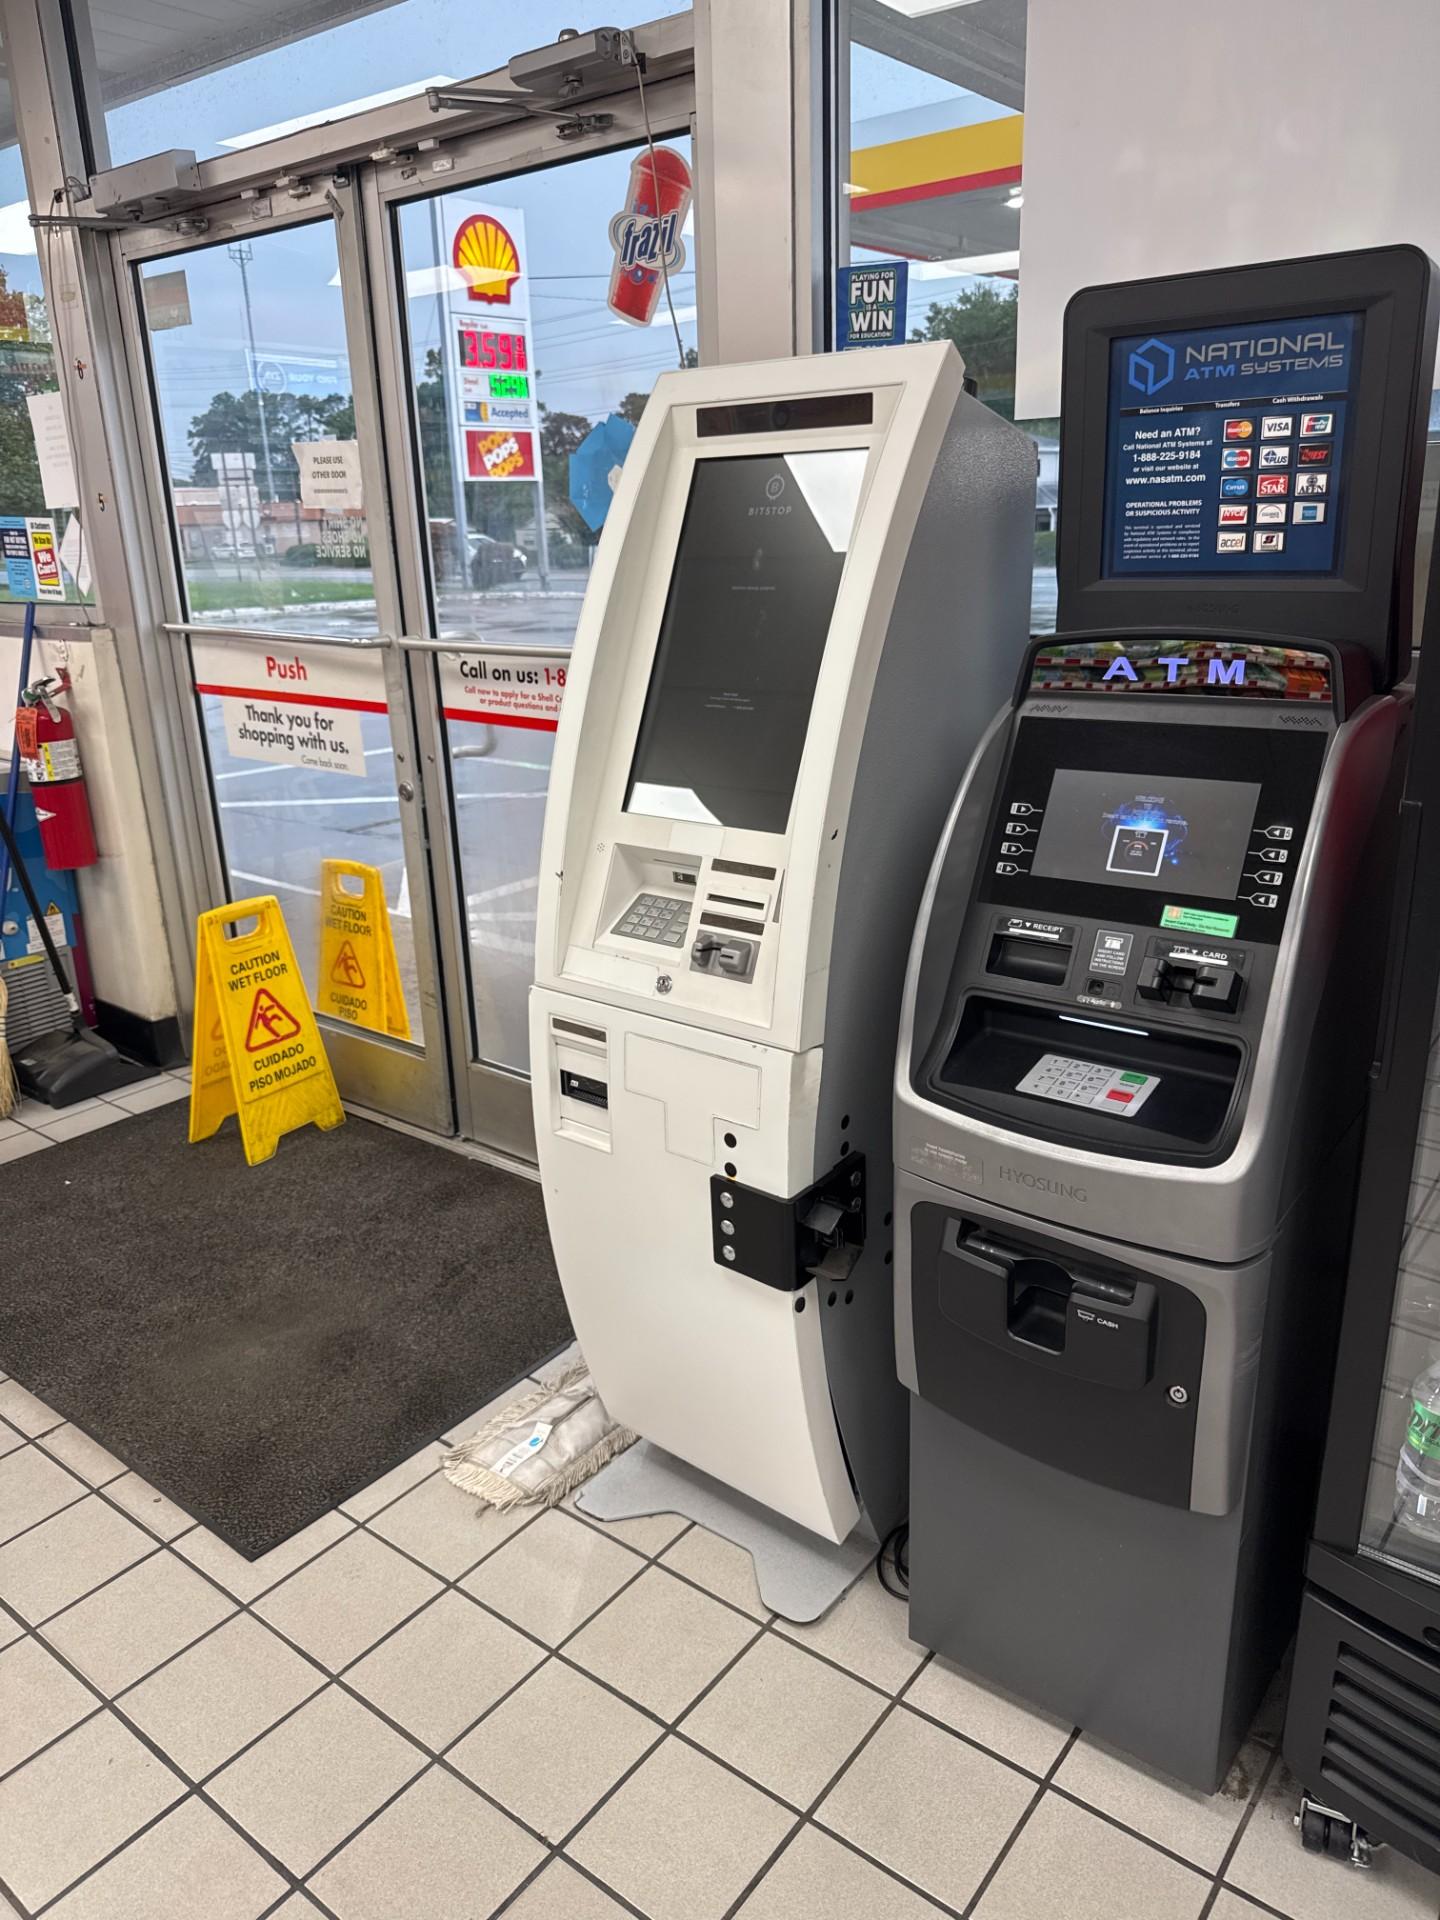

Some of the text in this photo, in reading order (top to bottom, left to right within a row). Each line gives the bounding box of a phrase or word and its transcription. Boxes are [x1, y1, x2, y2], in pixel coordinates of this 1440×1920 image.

[621, 214, 677, 266] frazil
[852, 273, 879, 281] PLAYING
[851, 280, 893, 304] FUN
[851, 310, 892, 332] WIN
[1185, 332, 1345, 364] NATIONAL
[1184, 354, 1343, 381] ATM SYSTEMS
[1287, 394, 1323, 403] Withdrawals
[491, 407, 529, 420] Accepted
[1135, 430, 1158, 439] Need
[1174, 427, 1200, 437] ATM?
[1266, 421, 1290, 432] VISA
[313, 456, 343, 465] PLEASE USE
[1133, 450, 1200, 462] 1-888-225-9184
[1270, 456, 1287, 464] PLUS
[312, 470, 347, 479] OTHER DOOR
[1126, 474, 1206, 485] www.nasatm.com
[1298, 485, 1324, 494] AFFN
[98, 493, 105, 511] 5
[748, 506, 792, 517] BITSTOP
[1224, 509, 1247, 517] NYCE
[1221, 536, 1244, 548] accel
[38, 551, 52, 562] We
[37, 561, 56, 574] Card
[266, 656, 307, 680] Push
[460, 660, 487, 679] Call
[492, 668, 511, 681] on
[517, 671, 538, 684] us:
[1102, 656, 1246, 685] ATM
[465, 686, 476, 694] Call
[493, 688, 499, 696] to
[501, 690, 519, 700] apply
[521, 691, 530, 699] for
[538, 693, 553, 702] Shell
[488, 699, 511, 707] product
[513, 701, 543, 711] questions
[546, 704, 558, 712] and
[245, 704, 334, 731] Thank you for
[239, 723, 349, 754] shopping with us.
[301, 754, 318, 766] Come
[319, 757, 333, 768] back
[330, 904, 367, 921] CAUTION
[344, 920, 372, 936] FLOOR
[1032, 922, 1228, 960] RECEIPT CARD
[229, 950, 281, 976] CAUTION
[228, 963, 289, 992] WET FLOOR
[330, 992, 367, 1010] CUIDADO
[253, 1043, 304, 1072] CUIDADO
[249, 1055, 317, 1093] PISO MOJADO
[1000, 1165, 1087, 1203] HYOSUNG
[1097, 1318, 1118, 1329] CASH
